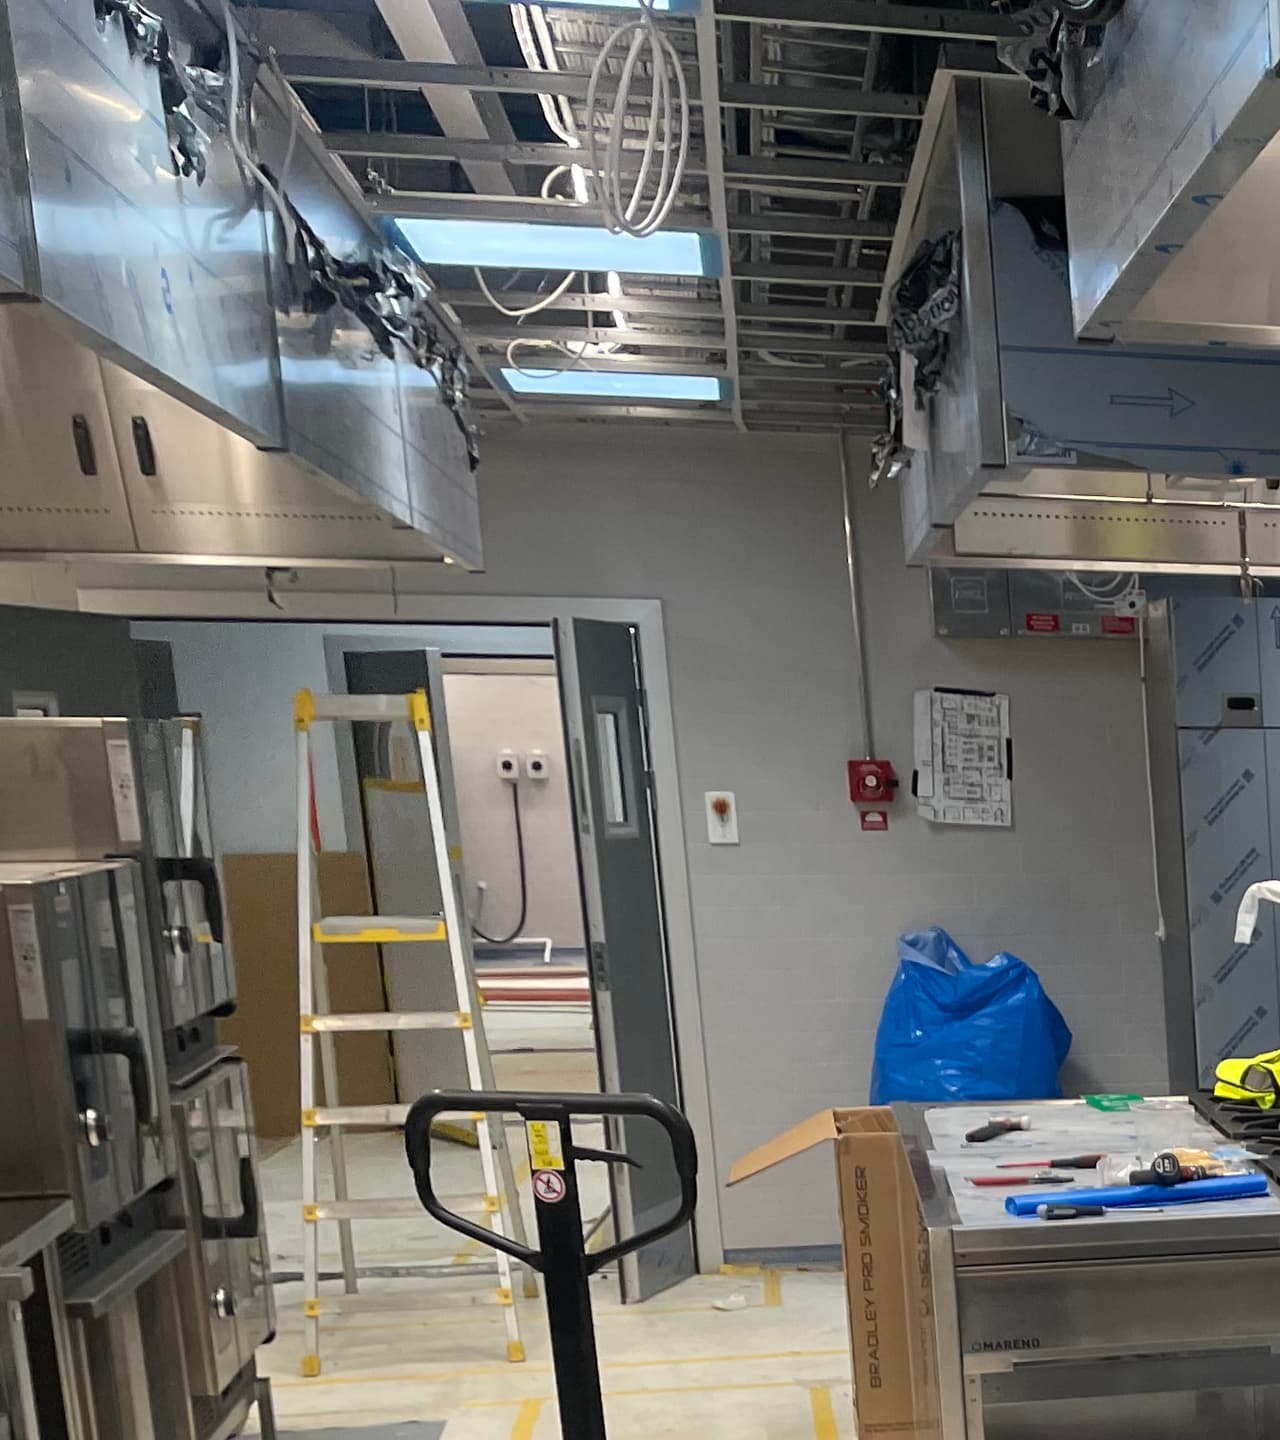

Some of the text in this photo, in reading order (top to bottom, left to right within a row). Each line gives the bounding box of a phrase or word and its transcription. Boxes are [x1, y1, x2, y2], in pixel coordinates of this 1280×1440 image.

[855, 1166, 882, 1388] BRADLEY PRO SMOKER
[983, 1338, 1040, 1351] MARENO
